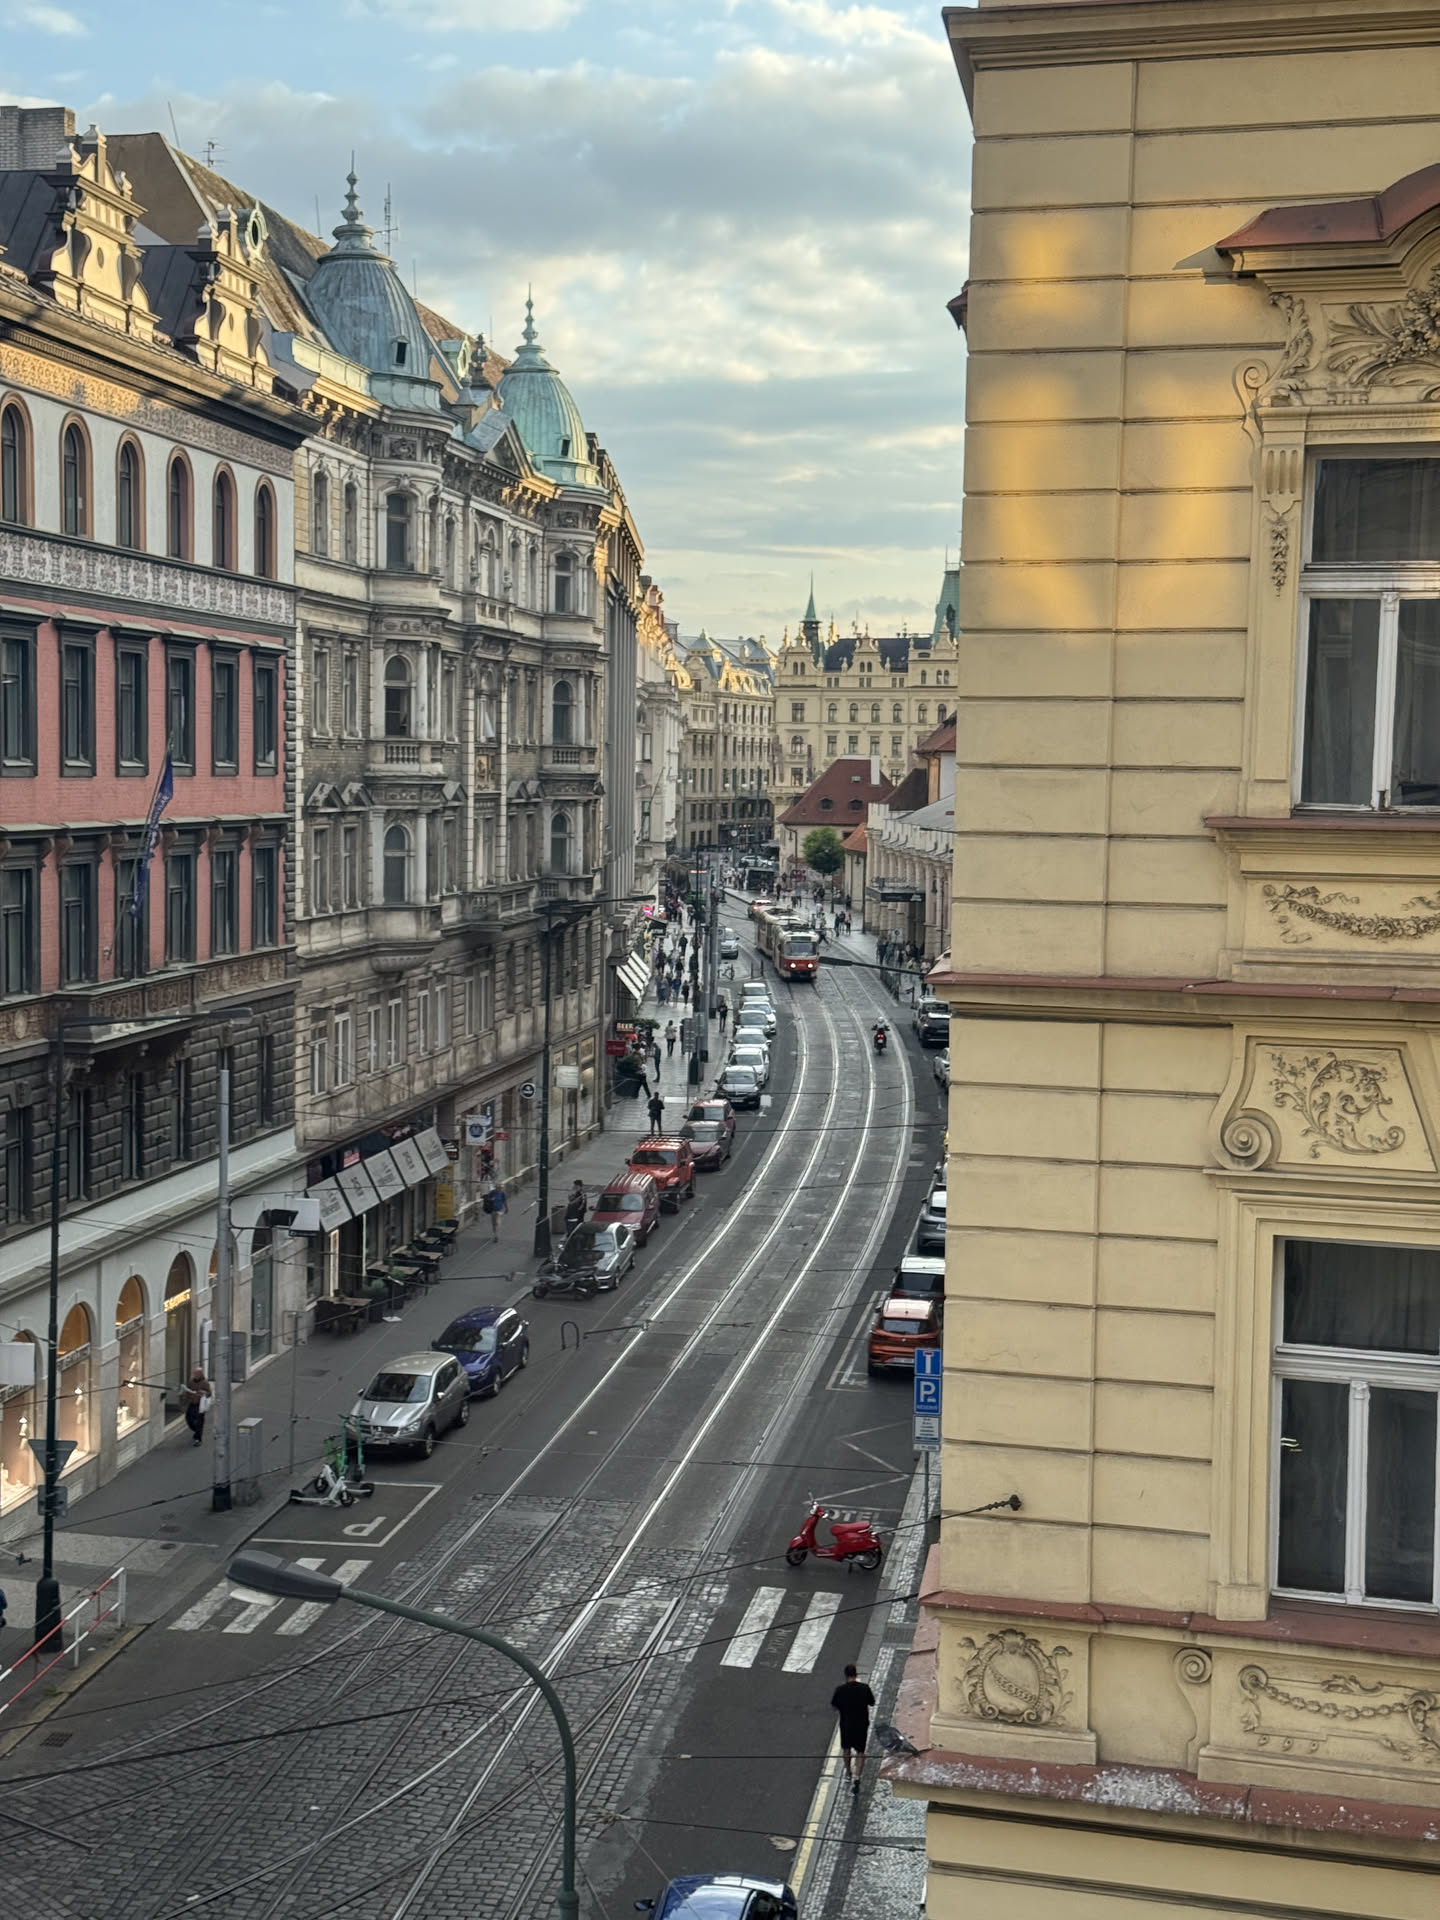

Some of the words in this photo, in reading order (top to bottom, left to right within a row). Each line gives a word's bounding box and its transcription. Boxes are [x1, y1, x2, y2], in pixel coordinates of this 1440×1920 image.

[920, 1381, 936, 1403] P
[343, 1516, 387, 1537] P
[808, 1508, 885, 1525] OTEL
